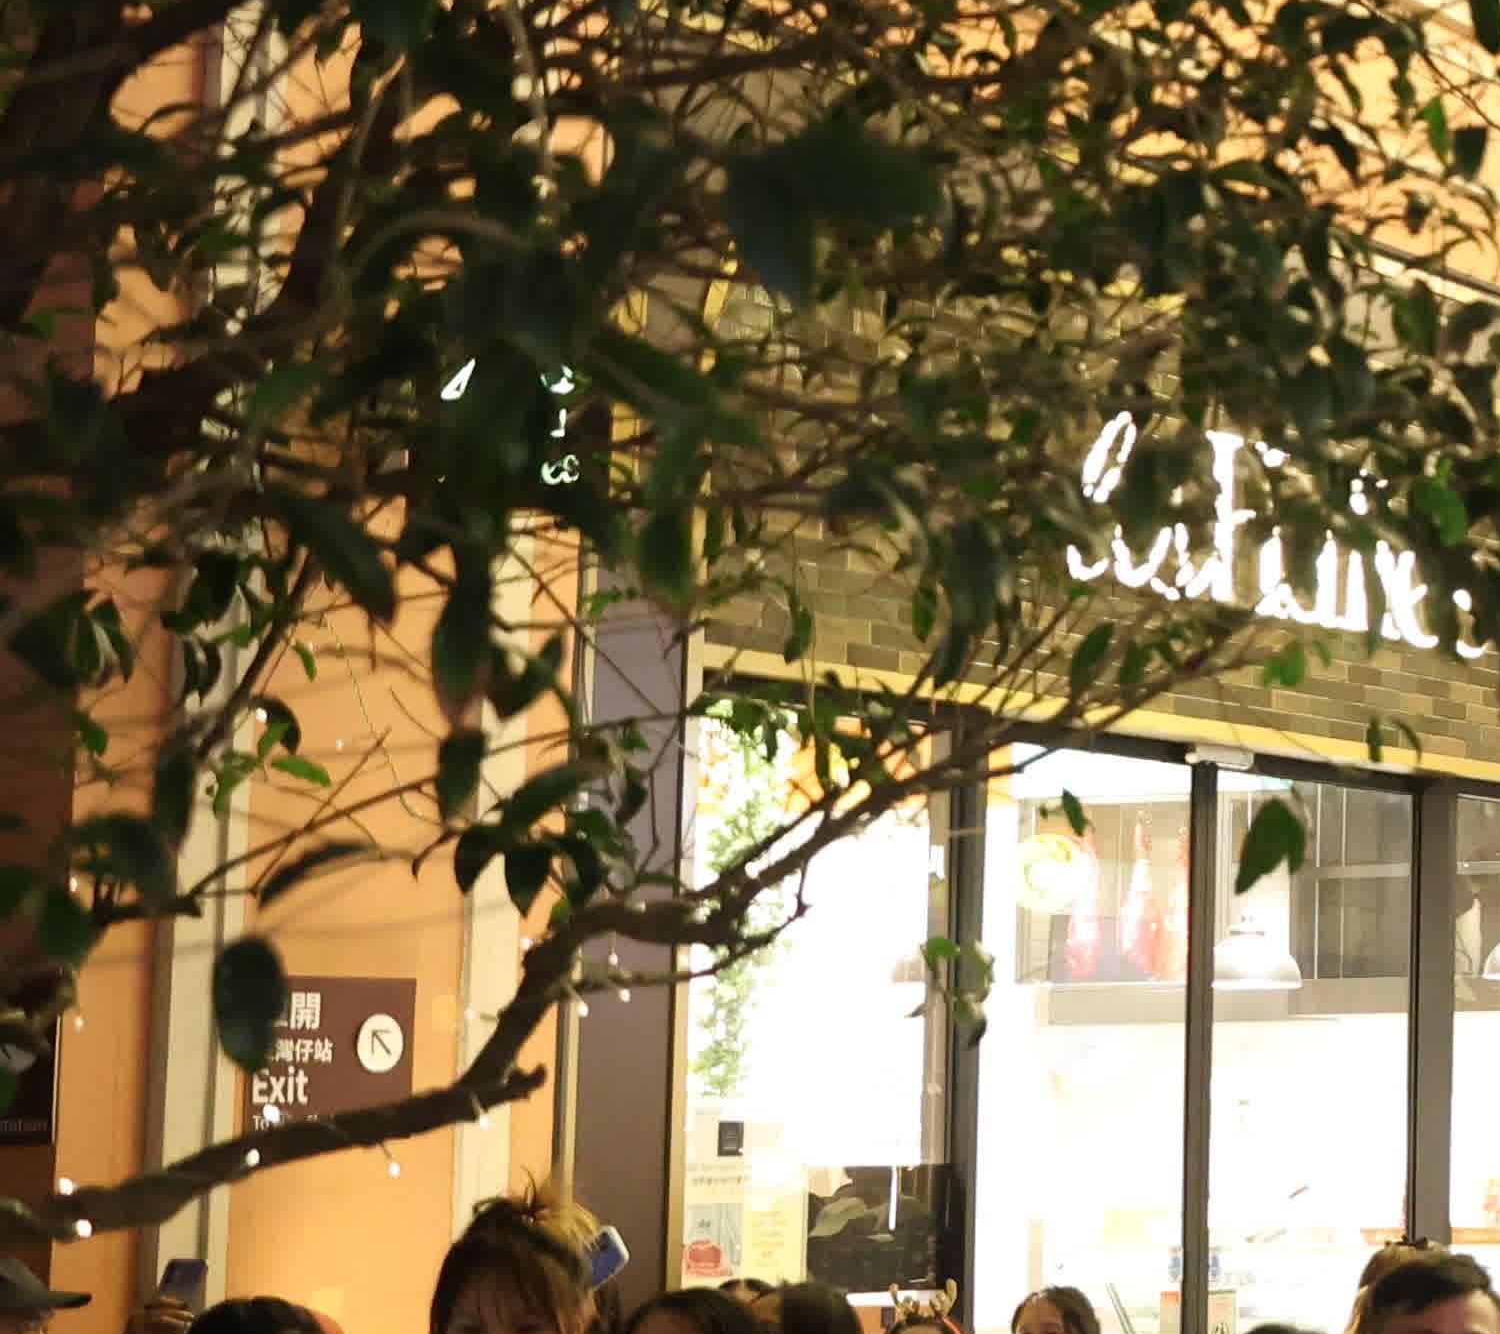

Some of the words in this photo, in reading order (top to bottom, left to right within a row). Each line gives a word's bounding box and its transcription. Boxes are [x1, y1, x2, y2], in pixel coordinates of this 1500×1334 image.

[268, 1037, 333, 1063] 灣仔站
[252, 1066, 308, 1104] Exit
